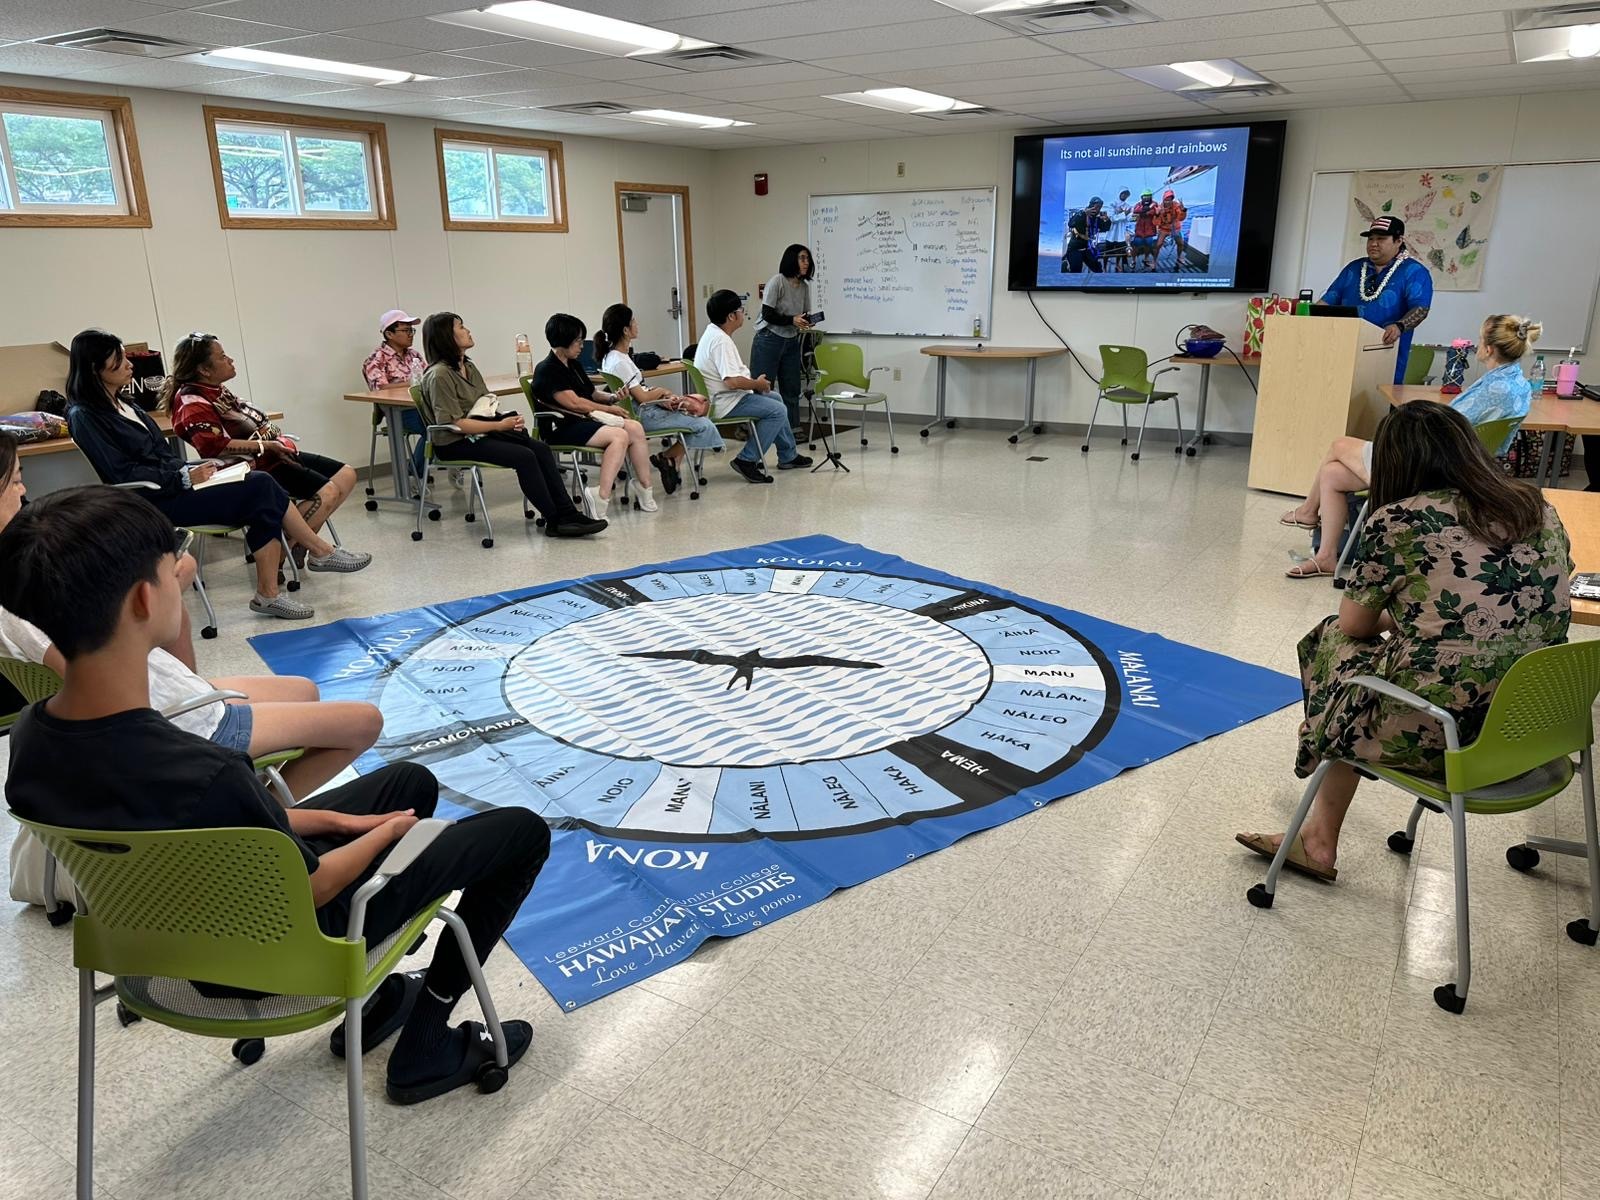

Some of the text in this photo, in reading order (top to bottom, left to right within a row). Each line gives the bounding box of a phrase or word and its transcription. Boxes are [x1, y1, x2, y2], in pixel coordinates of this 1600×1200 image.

[1060, 141, 1228, 159] Its not all sunshine and rainbows
[432, 664, 476, 673] NOIO
[1024, 668, 1075, 679] MANU
[1118, 650, 1161, 708] MALANAI
[1019, 689, 1087, 703] NĀLAN
[409, 716, 525, 753] KOMOHANA
[979, 730, 1031, 751] HAKA
[940, 750, 990, 776] HEMA
[598, 776, 634, 804] NOIO
[882, 765, 923, 795] HAKA
[585, 839, 709, 870] KONA
[544, 926, 624, 964] Leeward
[720, 863, 780, 890] College
[558, 871, 796, 978] HAWAIIAN STUDIES
[591, 961, 639, 987] Love
[721, 908, 758, 929] Live
[760, 892, 802, 916] pono.
